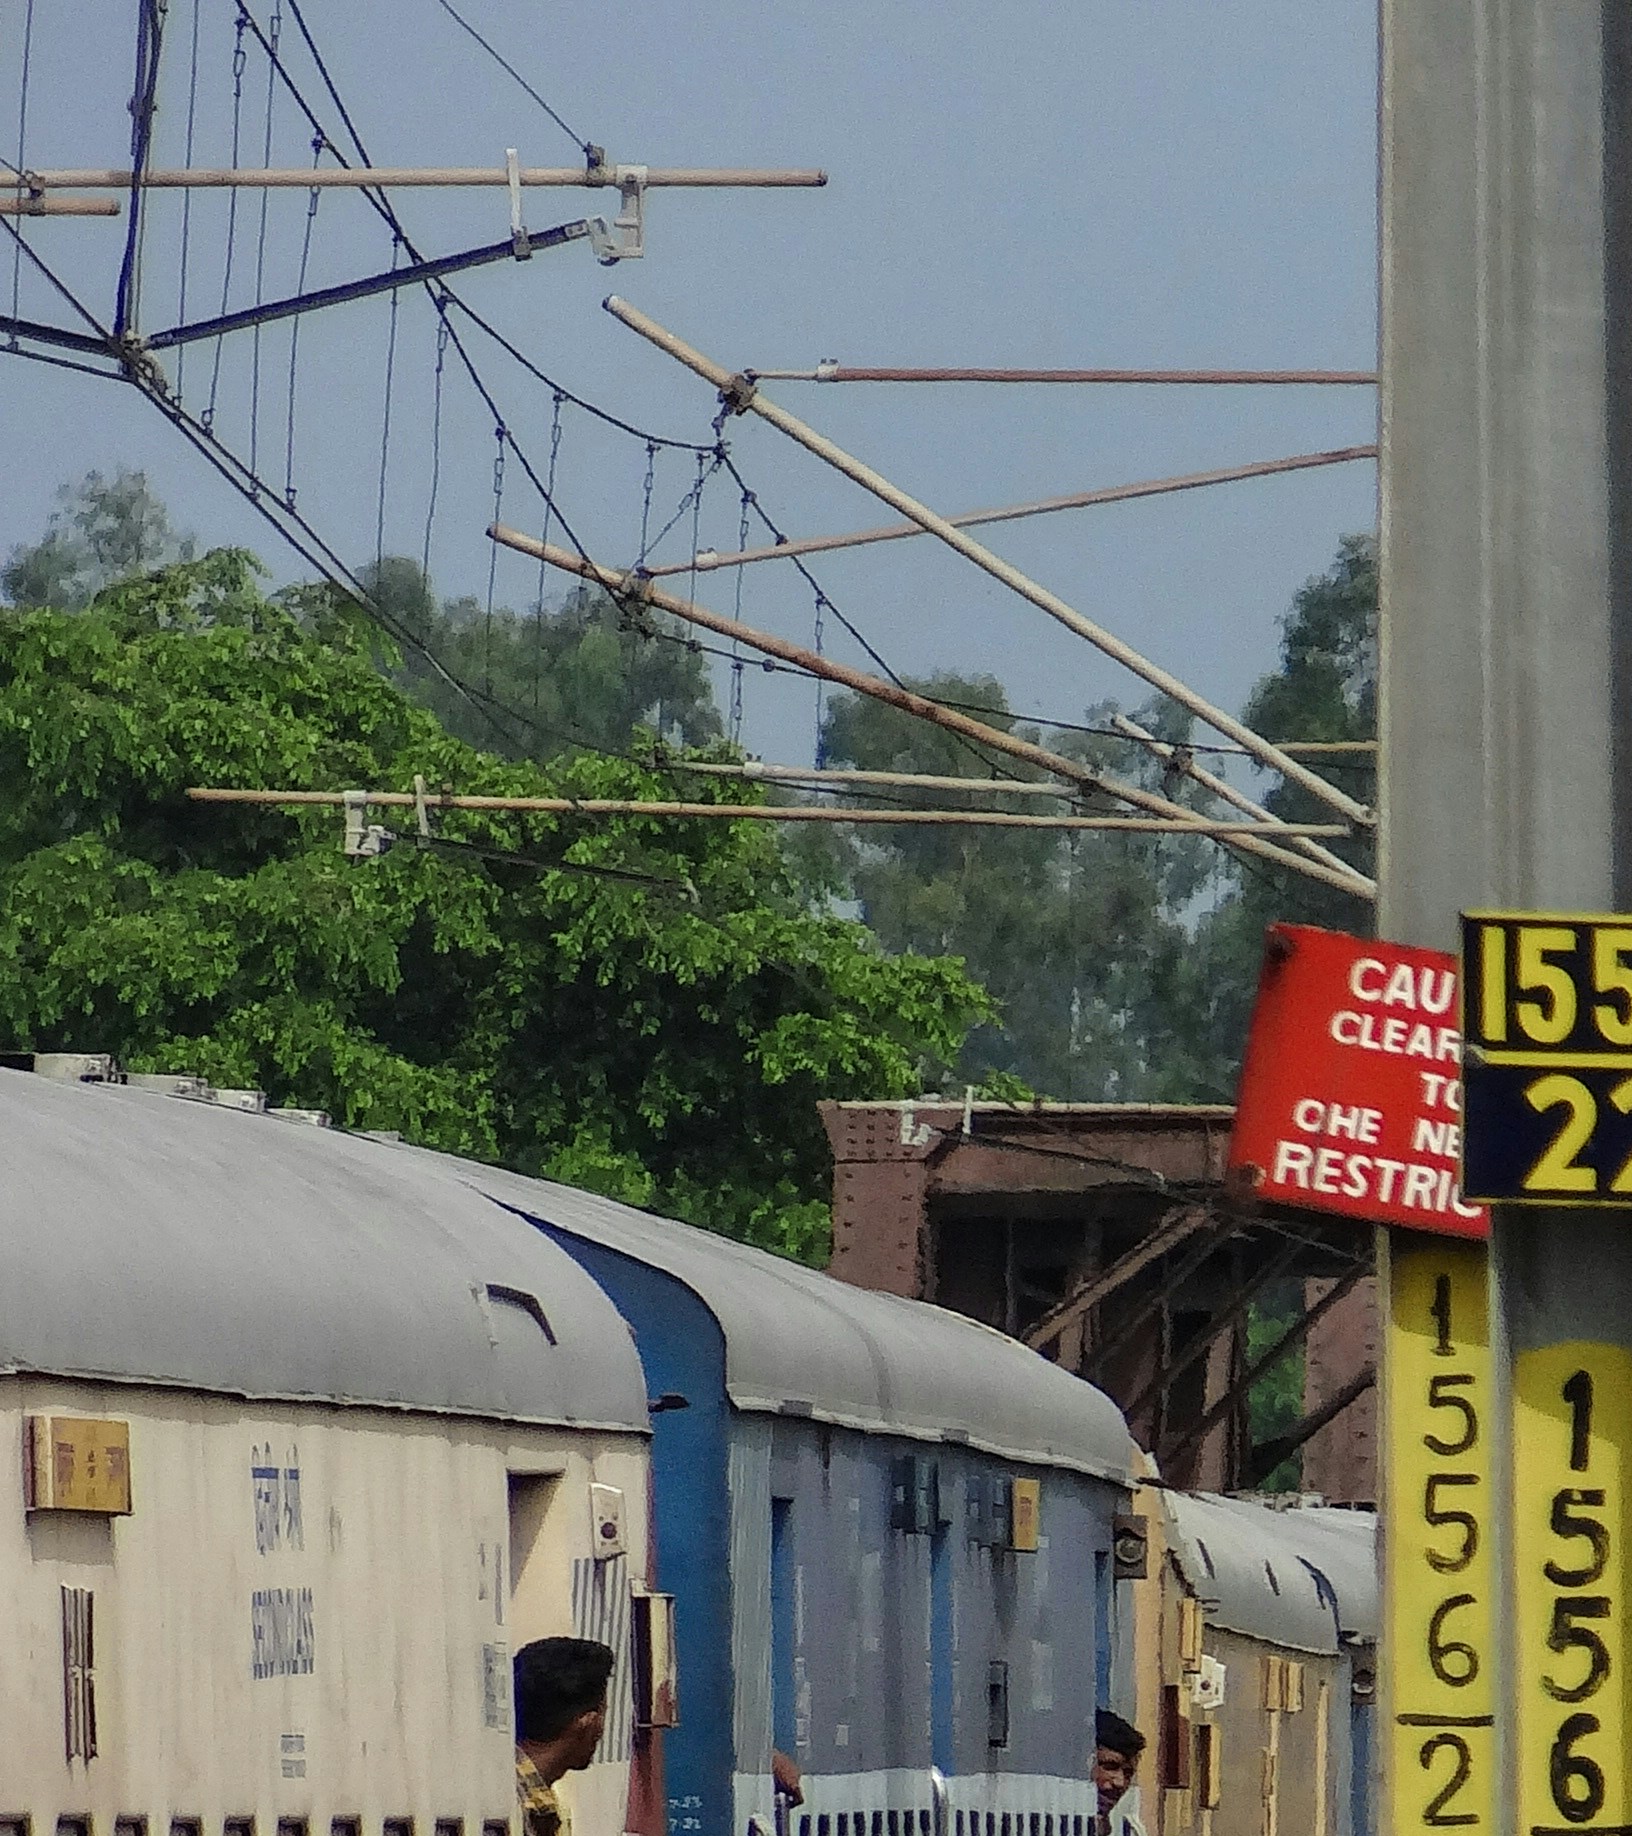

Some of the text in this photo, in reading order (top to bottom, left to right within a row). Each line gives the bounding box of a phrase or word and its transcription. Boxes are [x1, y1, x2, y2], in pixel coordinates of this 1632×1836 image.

[1349, 957, 1457, 1014] CAU
[1329, 1010, 1461, 1064] CLEAR
[1412, 1118, 1461, 1160] NE
[1273, 1140, 1484, 1219] RESTRIC
[1422, 1272, 1480, 1688] 1556
[1541, 1368, 1613, 1824] 1556
